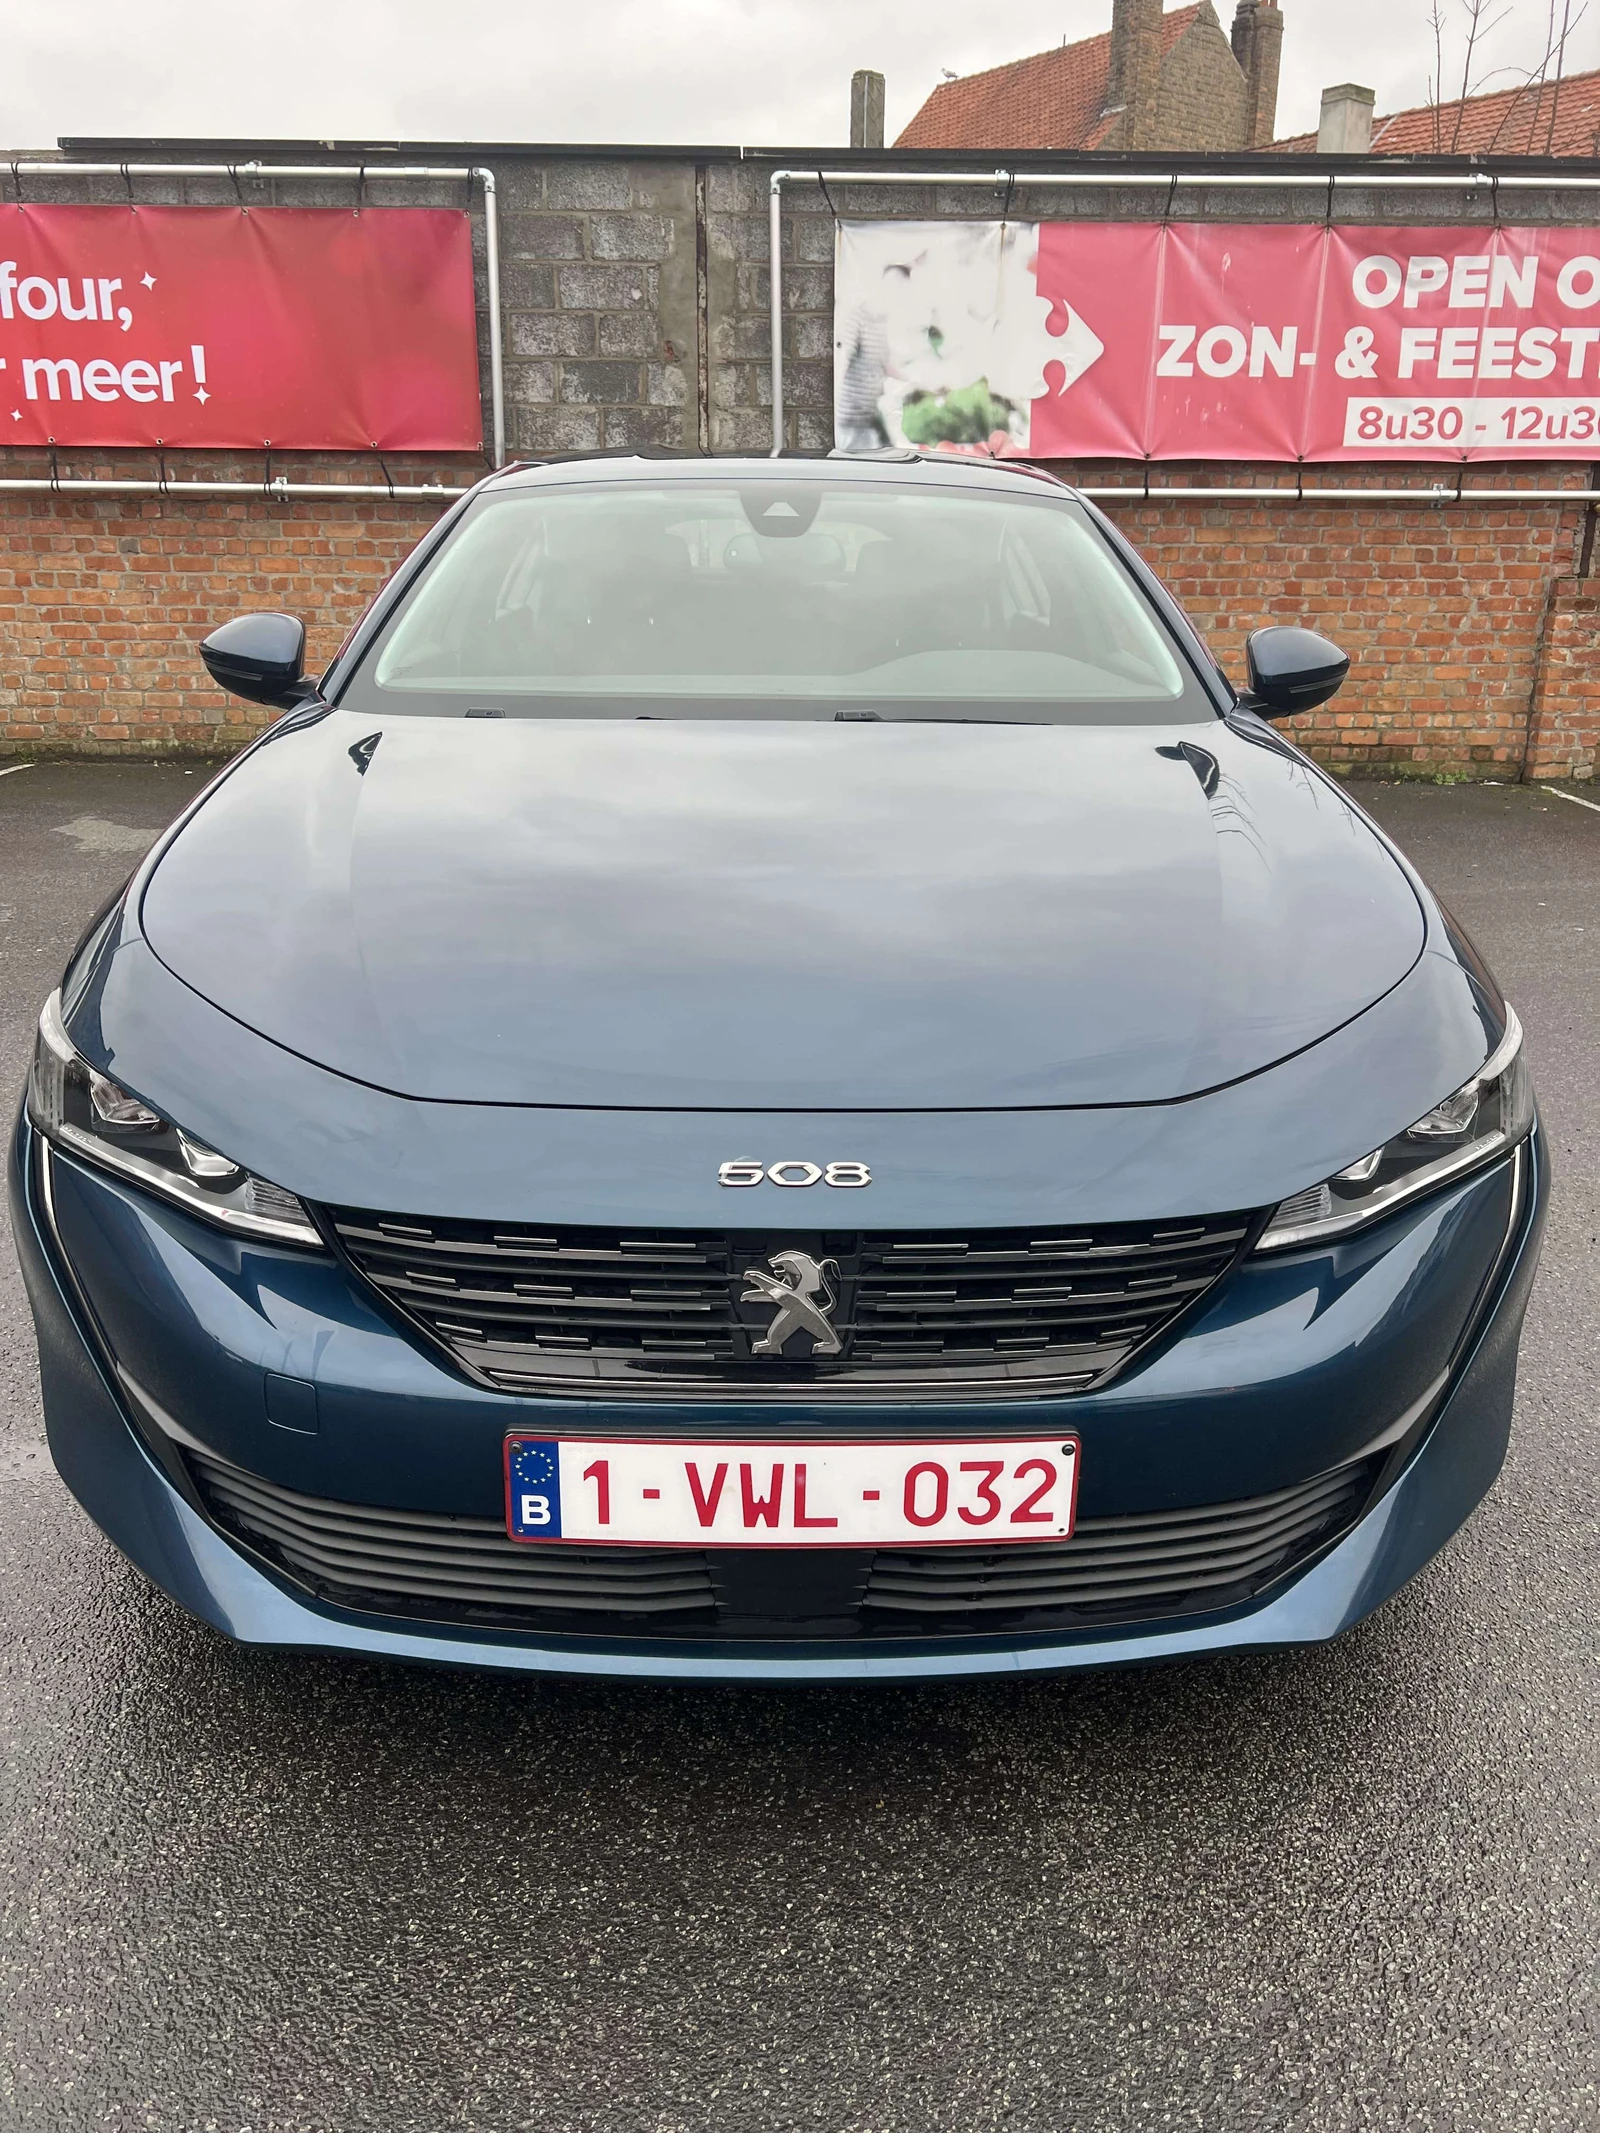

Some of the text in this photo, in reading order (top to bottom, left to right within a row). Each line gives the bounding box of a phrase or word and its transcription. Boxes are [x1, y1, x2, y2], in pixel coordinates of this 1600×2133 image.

[1352, 255, 1600, 309] OPEN O
[22, 344, 212, 405] meer!
[1156, 325, 1600, 379] ZON- & FEEST
[1357, 405, 1463, 441] 8u30
[1501, 405, 1600, 441] 12u3
[717, 1160, 873, 1187] 508
[521, 1494, 551, 1526] B
[583, 1459, 1058, 1529] 1-VWL-032
